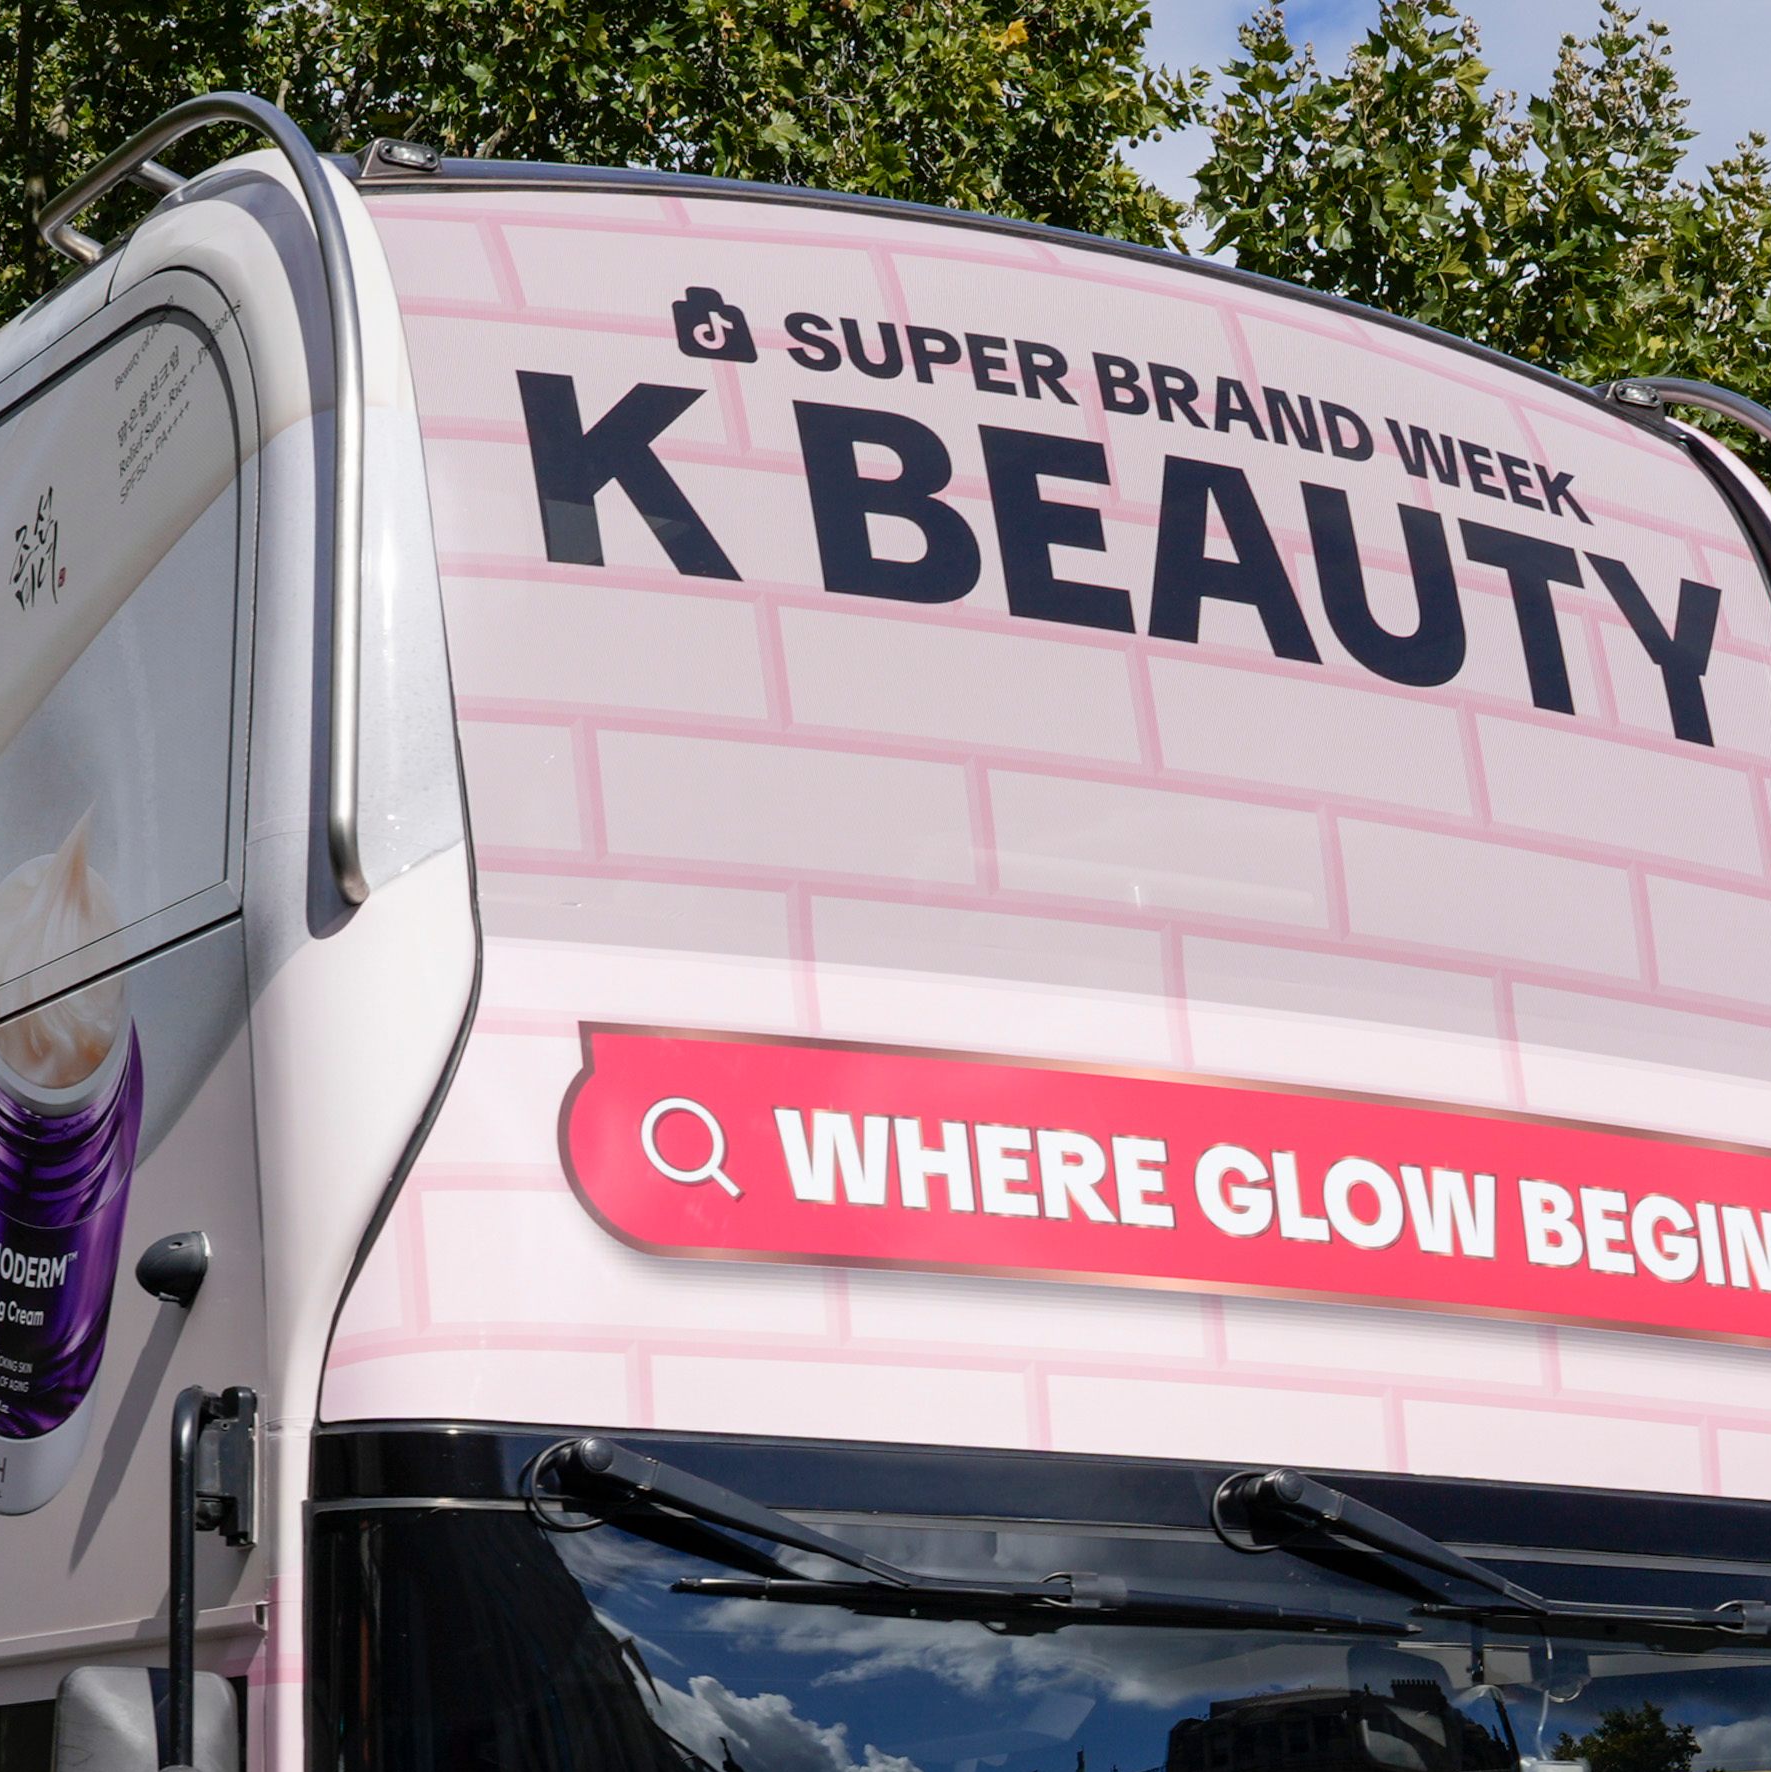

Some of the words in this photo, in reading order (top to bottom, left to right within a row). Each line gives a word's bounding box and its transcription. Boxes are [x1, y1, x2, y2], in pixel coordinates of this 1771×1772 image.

[786, 312, 1071, 404] SUPER
[1093, 353, 1374, 463] BRAND
[1385, 415, 1592, 525] WEEK
[515, 370, 744, 583] K
[792, 399, 1722, 749] BEAUTY
[773, 1104, 1178, 1232] WHERE
[1194, 1142, 1500, 1264] GLOW
[7, 1300, 44, 1327] Cream
